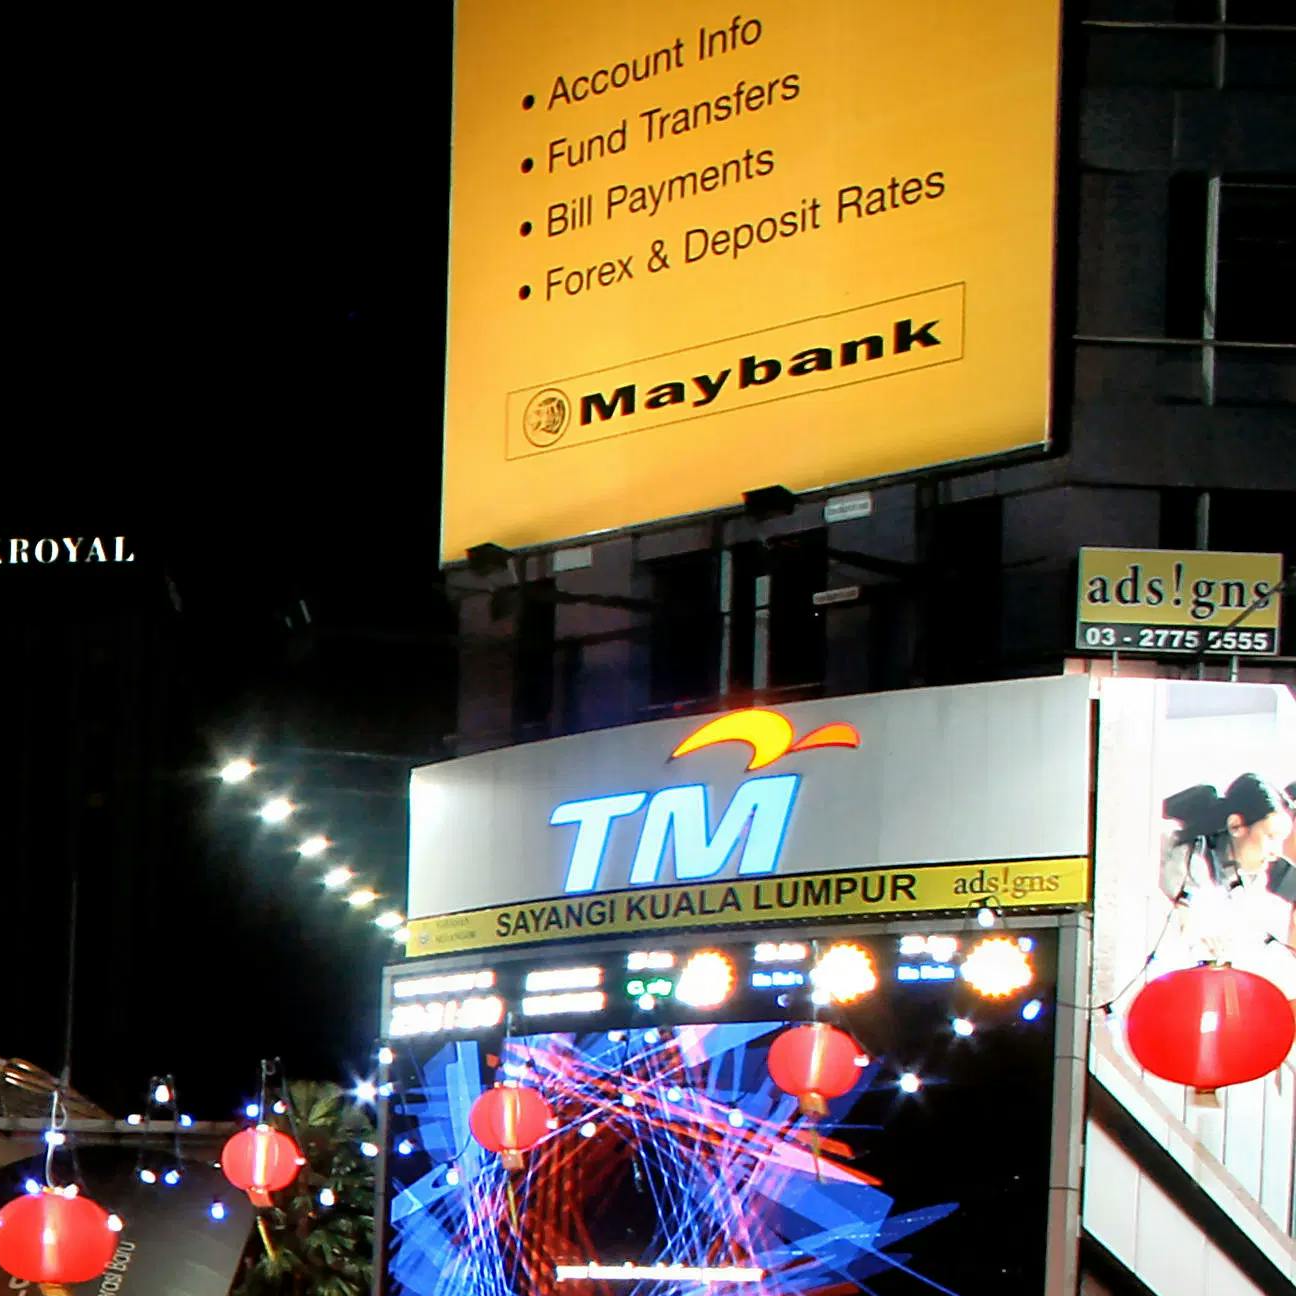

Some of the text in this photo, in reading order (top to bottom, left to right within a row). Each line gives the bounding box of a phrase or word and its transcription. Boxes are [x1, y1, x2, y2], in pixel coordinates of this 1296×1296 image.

[547, 15, 763, 110] Account Info
[548, 73, 800, 174] Fund Transfers
[546, 171, 946, 301] Forex & Deposit Rates
[547, 149, 775, 237] Bill Payments
[579, 318, 942, 427] Maybank
[1085, 627, 1116, 646] 03
[1139, 629, 1199, 649] 2775
[1207, 631, 1269, 651] 5555
[1086, 564, 1272, 620] ads!gns
[551, 774, 800, 893] TM
[495, 899, 616, 939] SAYANGI
[629, 885, 738, 927] KUALA
[752, 873, 917, 910] LUMPUR
